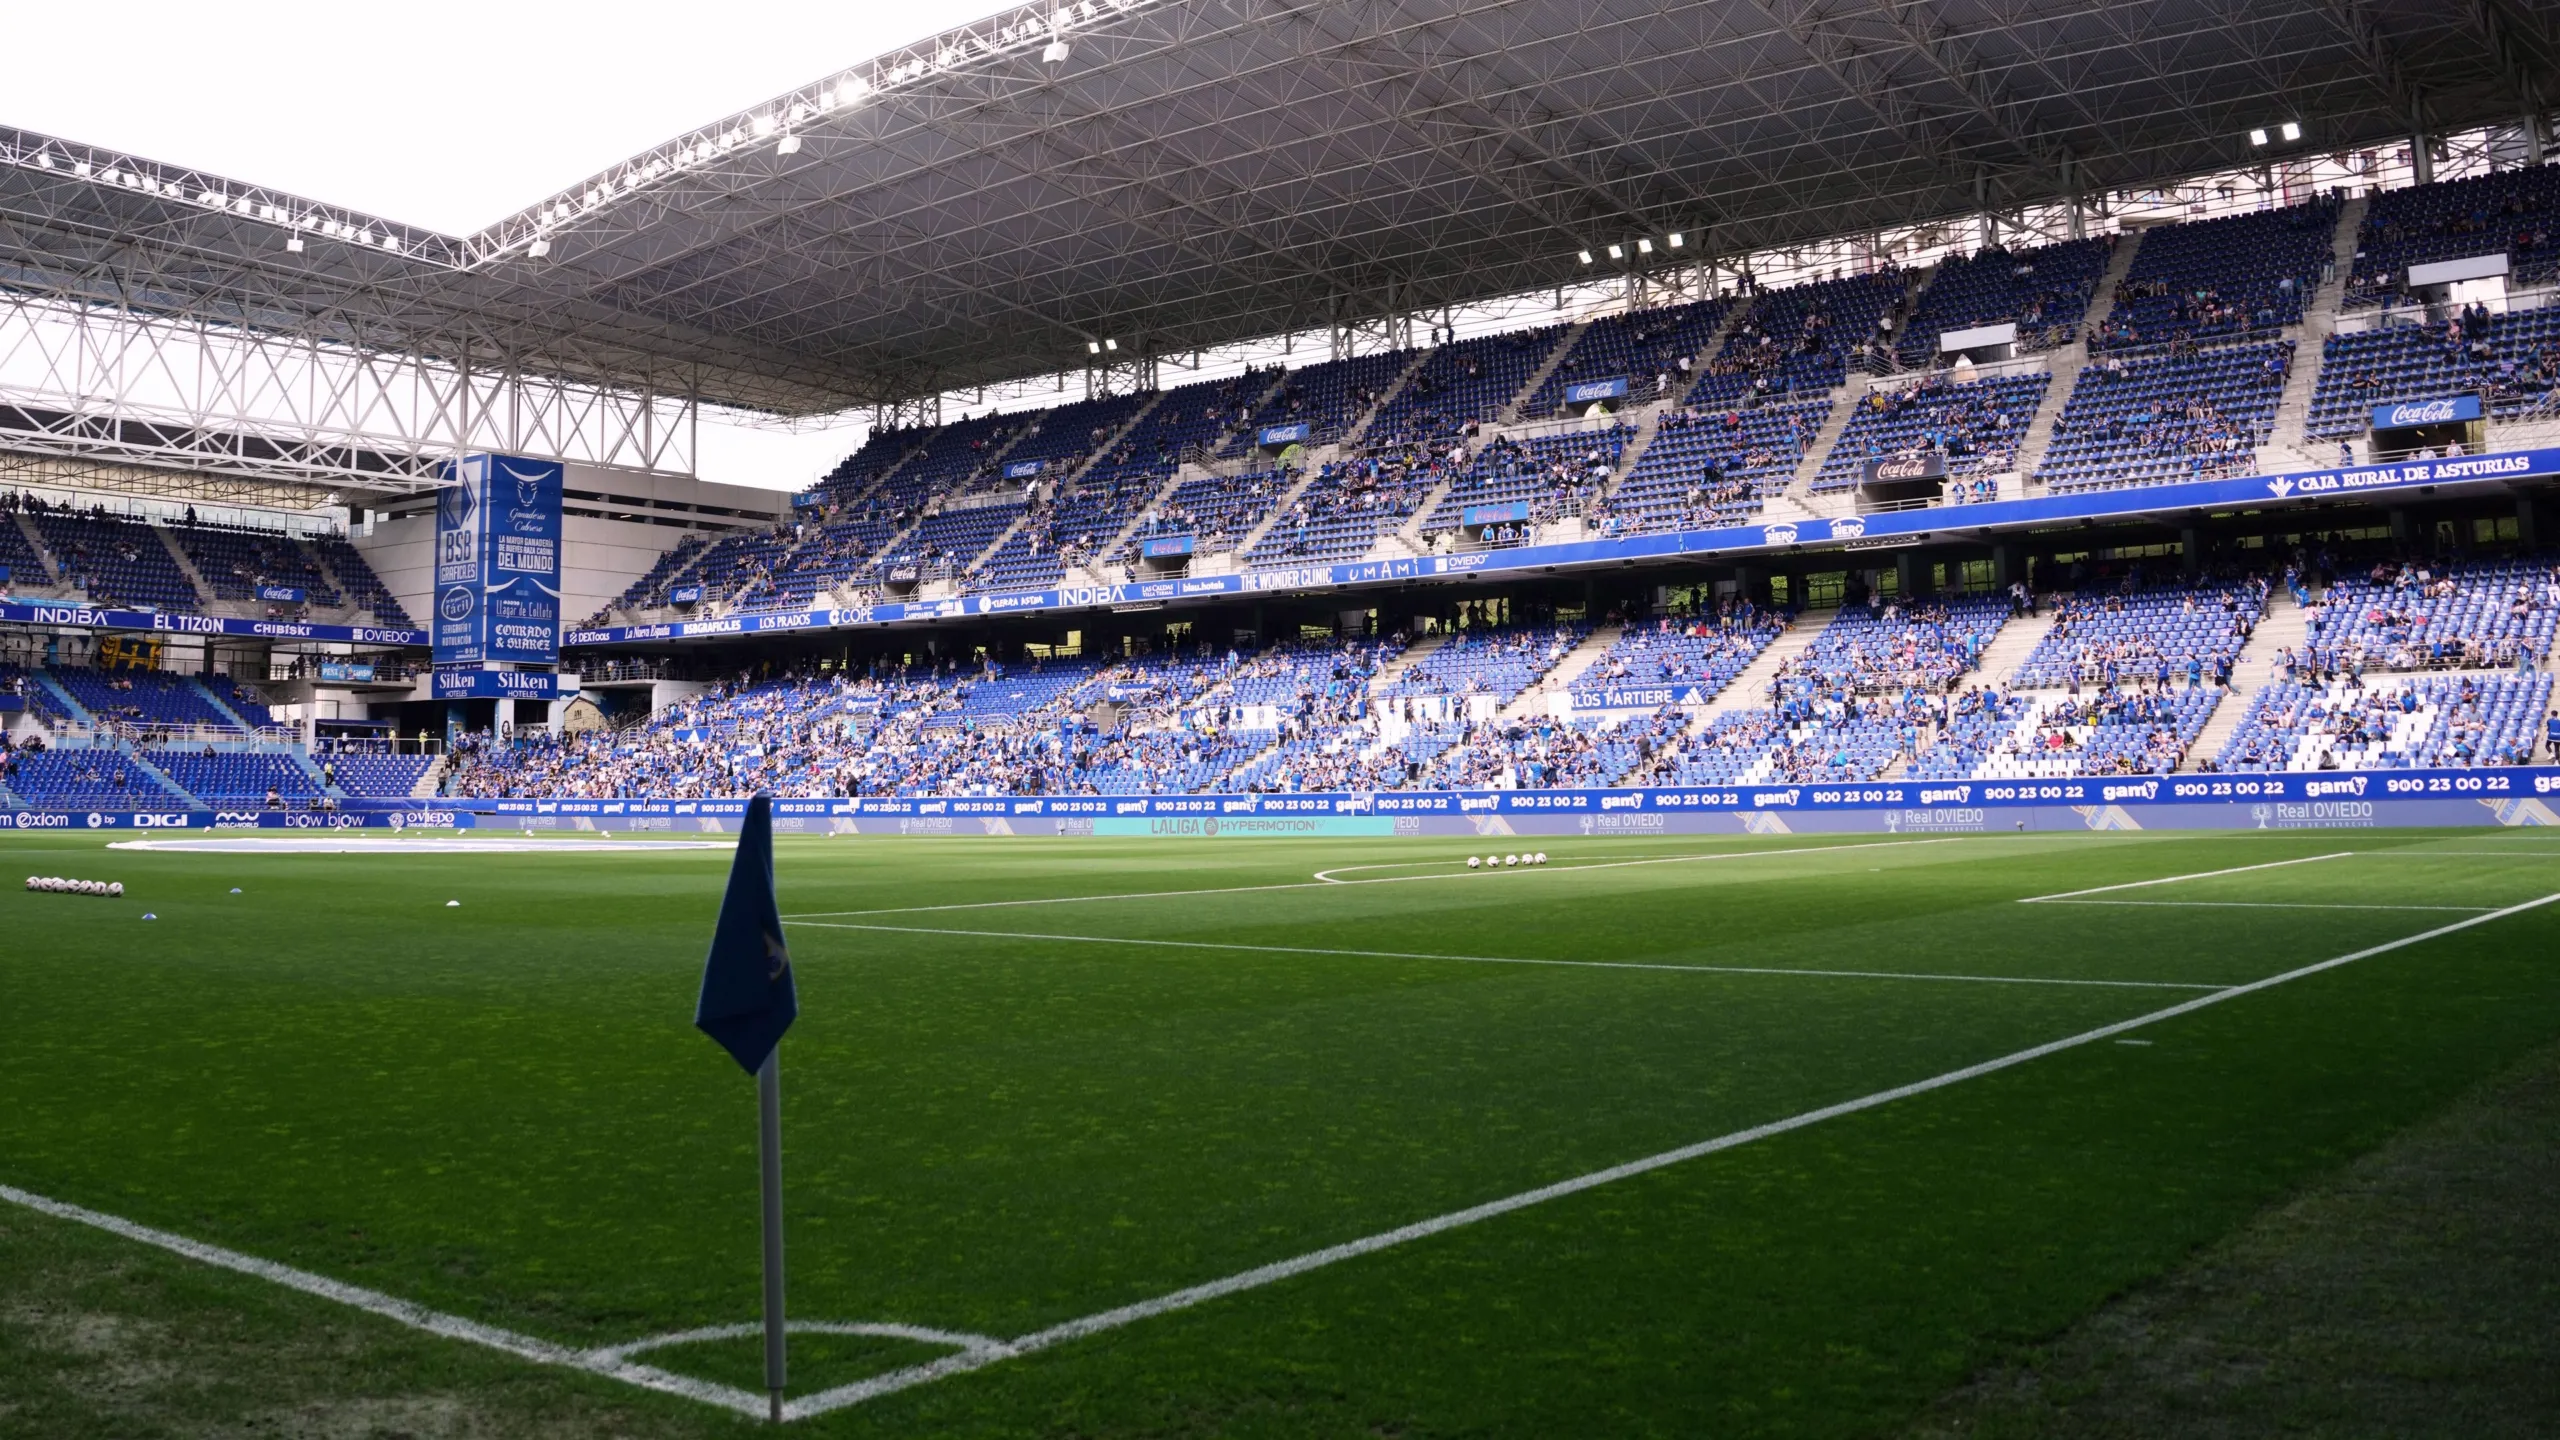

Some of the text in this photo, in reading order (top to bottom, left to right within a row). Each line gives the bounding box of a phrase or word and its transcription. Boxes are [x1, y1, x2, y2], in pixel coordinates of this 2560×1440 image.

[2298, 457, 2529, 492] CAJA RURAL DE ASTURIAS
[498, 535, 505, 543] LA
[446, 530, 471, 562] BSB
[498, 553, 553, 571] DEL MUNDO
[1450, 555, 1485, 566] OVIEDO
[1240, 568, 1333, 590] THE WONDER CLINIC
[1152, 584, 1174, 592] CALDAS
[1059, 588, 1125, 606] INDIBA
[904, 603, 923, 611] HOTEL
[34, 607, 107, 625] INDIBA
[154, 614, 174, 630] EL
[759, 615, 811, 629] LOS PRADOS
[841, 608, 874, 623] COPE
[624, 627, 632, 638] La
[683, 619, 741, 635] BSBGRAFICA.ES
[365, 629, 410, 643] OVIEDO
[495, 638, 505, 648] &
[440, 673, 475, 688] Silken
[498, 672, 548, 690] Silken
[508, 690, 538, 698] HOTELES
[1571, 690, 1672, 708] RLOS TARTIERE
[2175, 782, 2285, 796] 900 23 00 22
[2387, 777, 2509, 791] 900 23 00 22
[2535, 775, 2560, 793] ga
[1656, 794, 1738, 805] 900 23 00 22
[1814, 790, 1903, 803] 900 23 00 22
[1985, 787, 2084, 799] 900 23 00 22
[1156, 801, 1173, 811] 900
[1189, 801, 1202, 811] 00
[1204, 801, 1215, 811] 22
[1264, 800, 1283, 810] 900
[1300, 800, 1314, 810] 00
[1316, 800, 1328, 810] 22
[1378, 799, 1447, 809] 900 23 00 22
[1512, 796, 1587, 808] 900 23 00 22
[1905, 808, 1983, 823] Real OVIEDO
[2277, 802, 2373, 818] Real OVIEDO
[16, 812, 68, 828] exiom
[104, 815, 115, 825] bp
[134, 814, 187, 826] DIGI
[407, 812, 455, 822] OVIEDO
[772, 818, 804, 828] eal OVIEDO
[910, 818, 952, 828] Real OVIEDO
[1068, 818, 1084, 829] Real
[1393, 817, 1419, 829] IEDO
[1598, 814, 1664, 827] Real OVIEDO
[1151, 817, 1200, 835] LALIGA
[1220, 820, 1315, 831] HYPERMOTION
